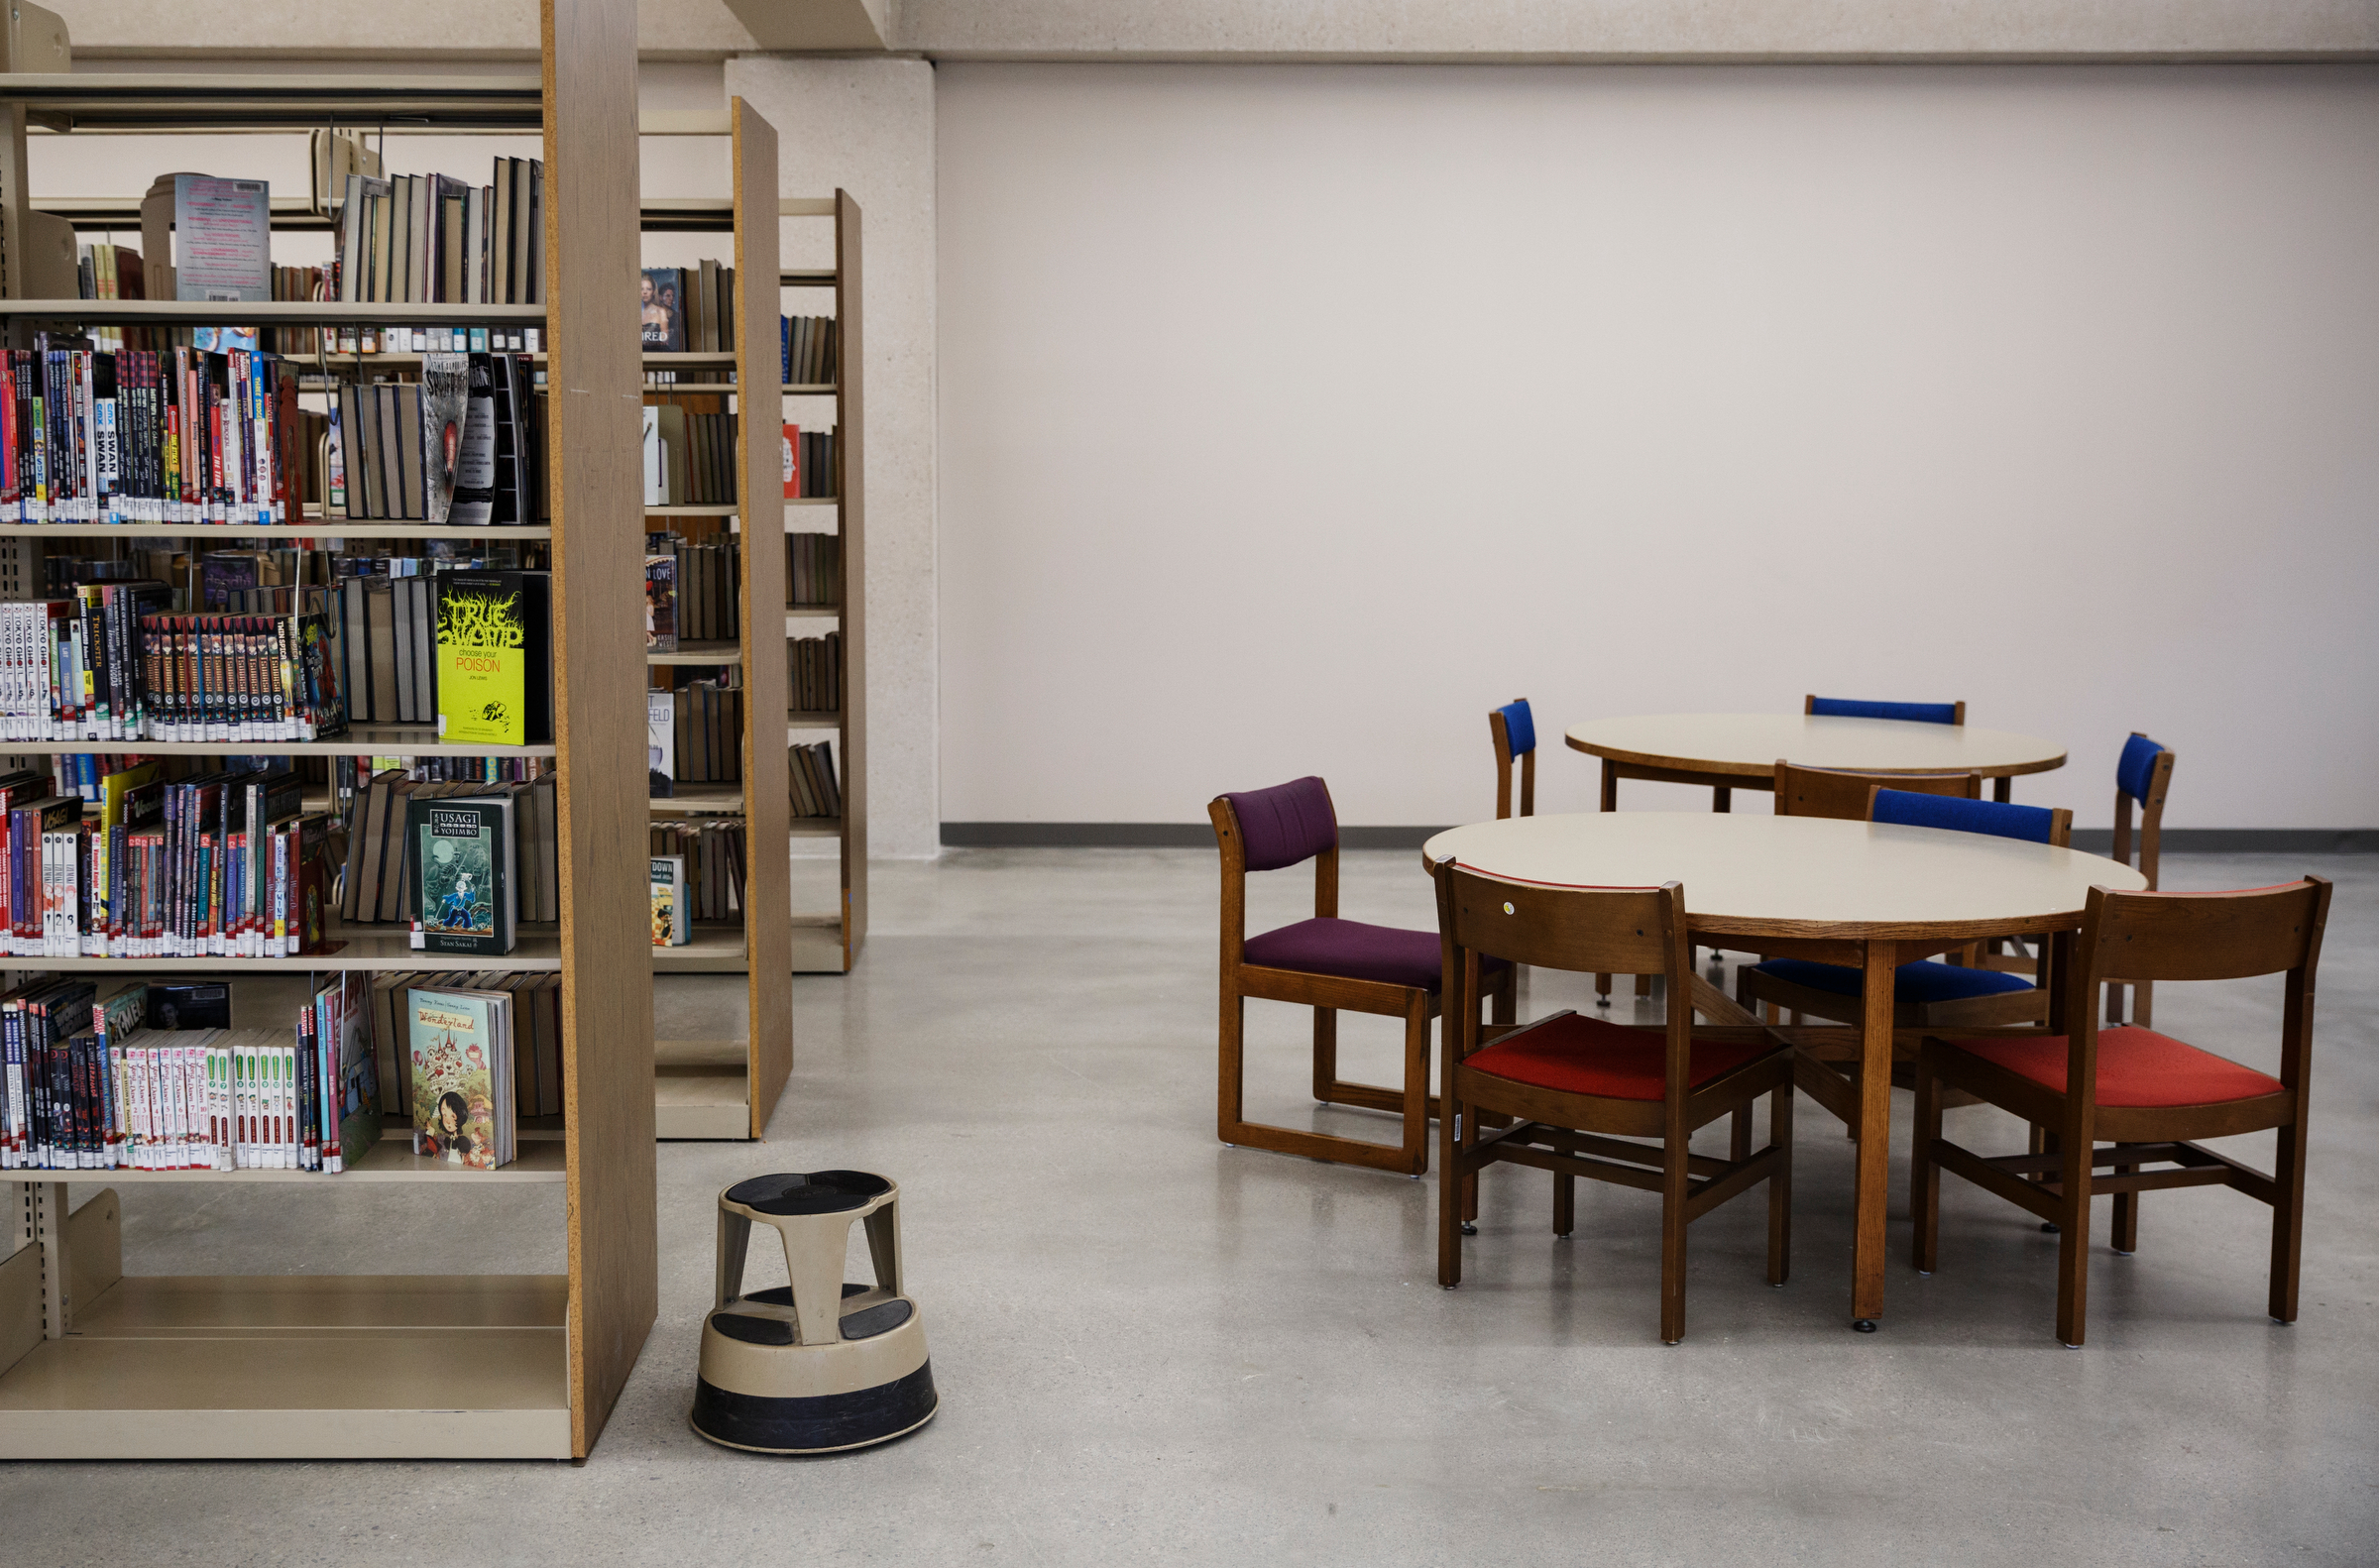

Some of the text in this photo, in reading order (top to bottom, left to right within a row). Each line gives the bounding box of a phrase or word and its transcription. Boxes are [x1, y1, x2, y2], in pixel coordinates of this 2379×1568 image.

[98, 430, 106, 473] SWAN
[108, 430, 116, 473] SWAN
[653, 568, 671, 580] LOVE
[93, 615, 102, 668] TRICKSTER
[279, 639, 287, 660] SPICA
[459, 648, 497, 660] choose your
[456, 657, 501, 673] POISON
[110, 663, 118, 688] WOODS
[440, 812, 477, 824] USAGI
[651, 862, 673, 873] DOWN
[418, 1010, 474, 1030] Wonderland
[128, 1063, 136, 1081] Yona
[137, 1063, 146, 1081] Yona
[149, 1064, 158, 1082] Yona
[160, 1062, 170, 1081] Yona
[173, 1062, 182, 1080] Yona
[186, 1061, 195, 1079] Yona
[197, 1063, 206, 1080] Yona
[88, 1062, 97, 1098] SERENADE
